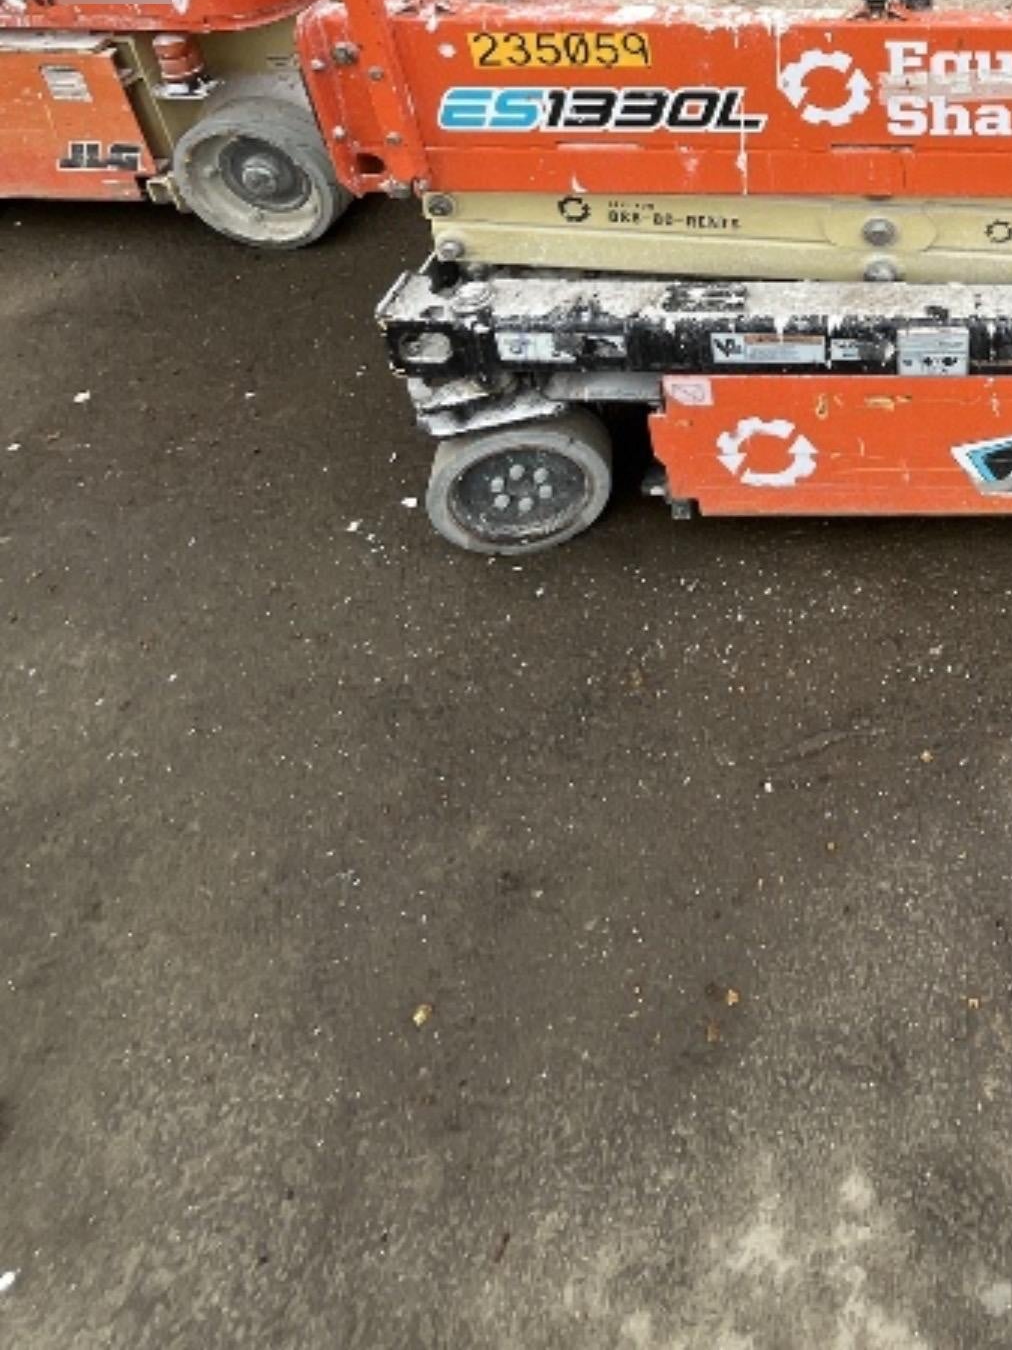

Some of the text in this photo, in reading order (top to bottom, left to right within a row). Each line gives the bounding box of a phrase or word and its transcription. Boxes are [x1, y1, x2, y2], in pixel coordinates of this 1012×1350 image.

[472, 32, 650, 67] 235059
[438, 87, 768, 132] ES1330L
[57, 141, 142, 171] JLG
